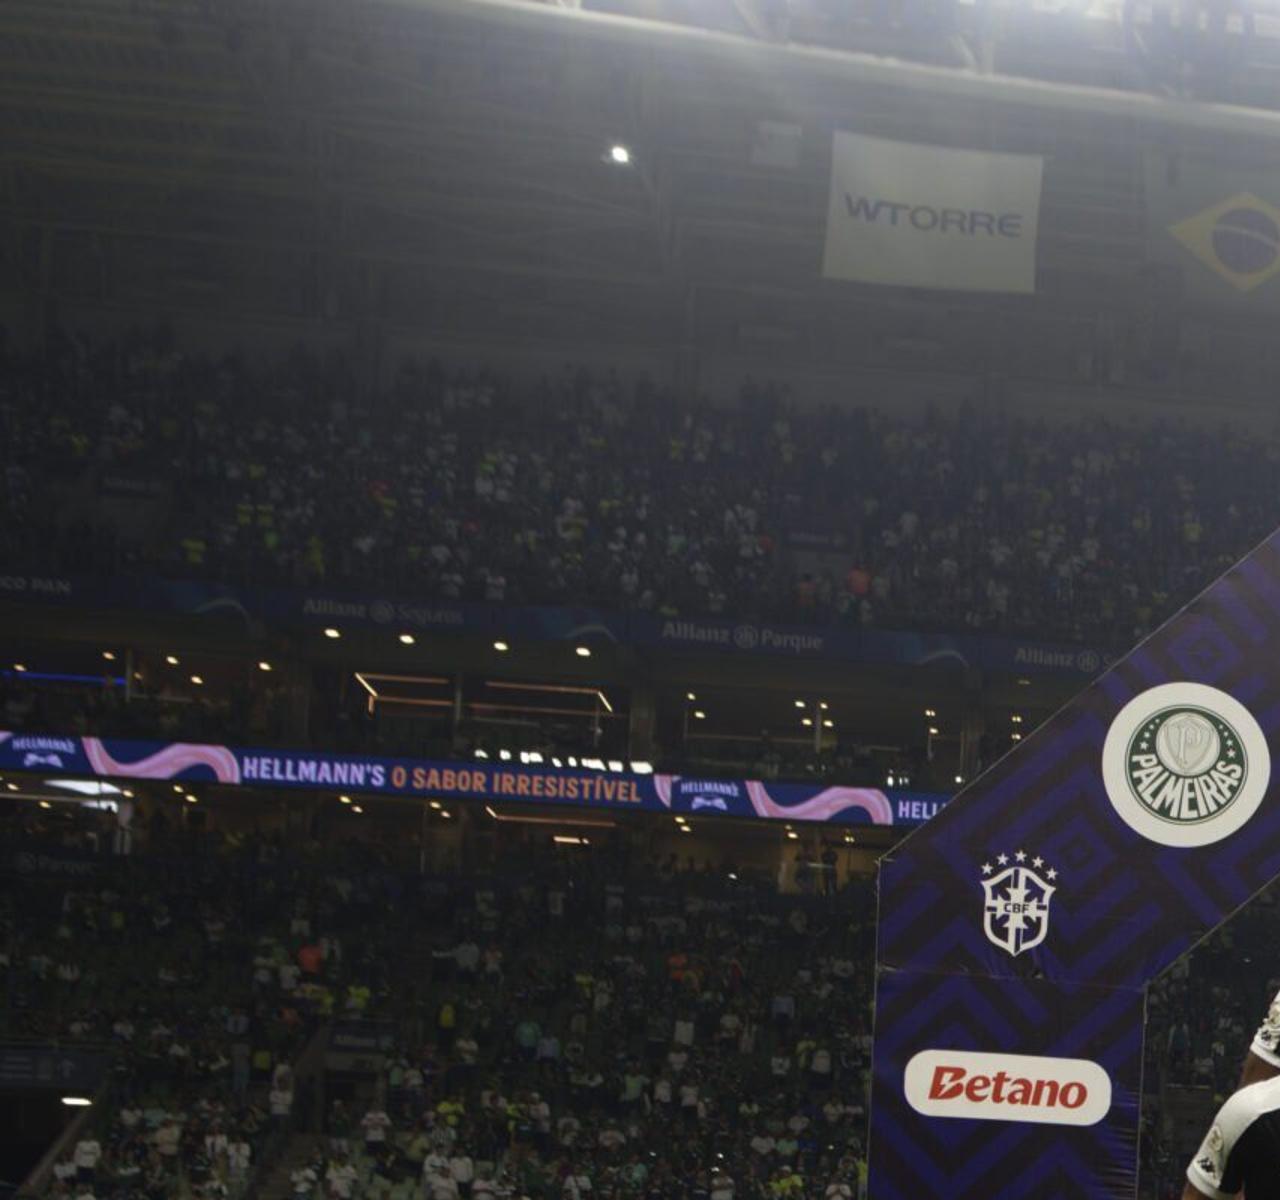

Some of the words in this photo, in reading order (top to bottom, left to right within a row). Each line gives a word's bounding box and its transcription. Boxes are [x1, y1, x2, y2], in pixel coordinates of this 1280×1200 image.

[843, 193, 1022, 238] WTORRE
[31, 577, 73, 595] PAN
[303, 598, 367, 618] Allianz
[662, 622, 730, 643] Allianz
[760, 629, 824, 652] Parque
[1013, 647, 1076, 667] Allianz
[243, 757, 385, 787] HELLMANN'S
[392, 767, 406, 787] O
[412, 768, 487, 793] SABOR
[493, 769, 641, 803] IRRESISTÍVEL
[680, 781, 739, 798] HELLMANN'S
[1131, 753, 1243, 820] PALMEIRAS
[1003, 901, 1030, 914] CBF
[928, 1066, 1088, 1110] Betano
